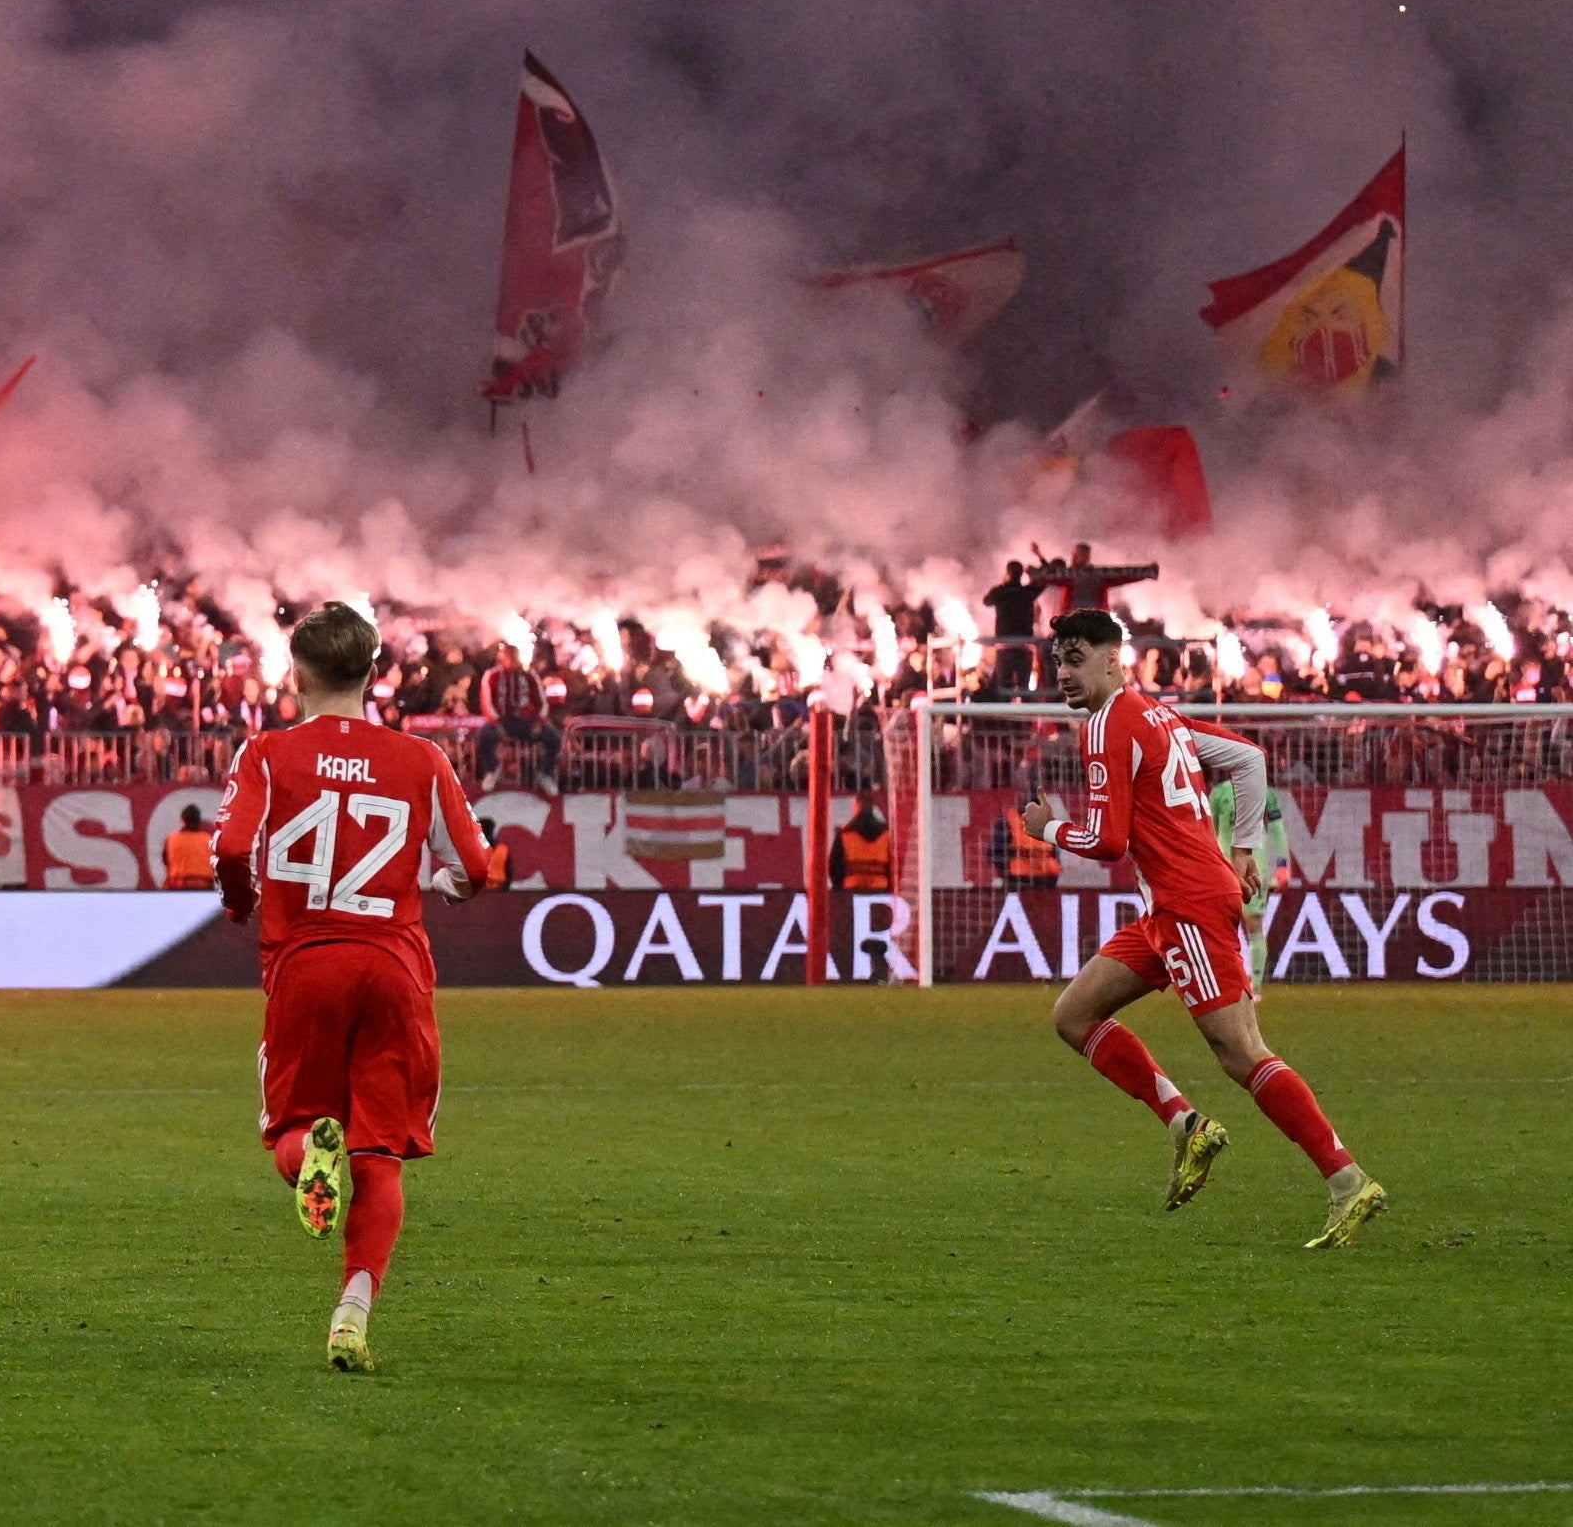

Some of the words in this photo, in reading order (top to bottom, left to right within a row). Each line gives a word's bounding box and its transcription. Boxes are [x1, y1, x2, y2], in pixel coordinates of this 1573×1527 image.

[316, 753, 377, 783] KARL
[267, 789, 410, 919] 42
[521, 893, 917, 989] QATAR
